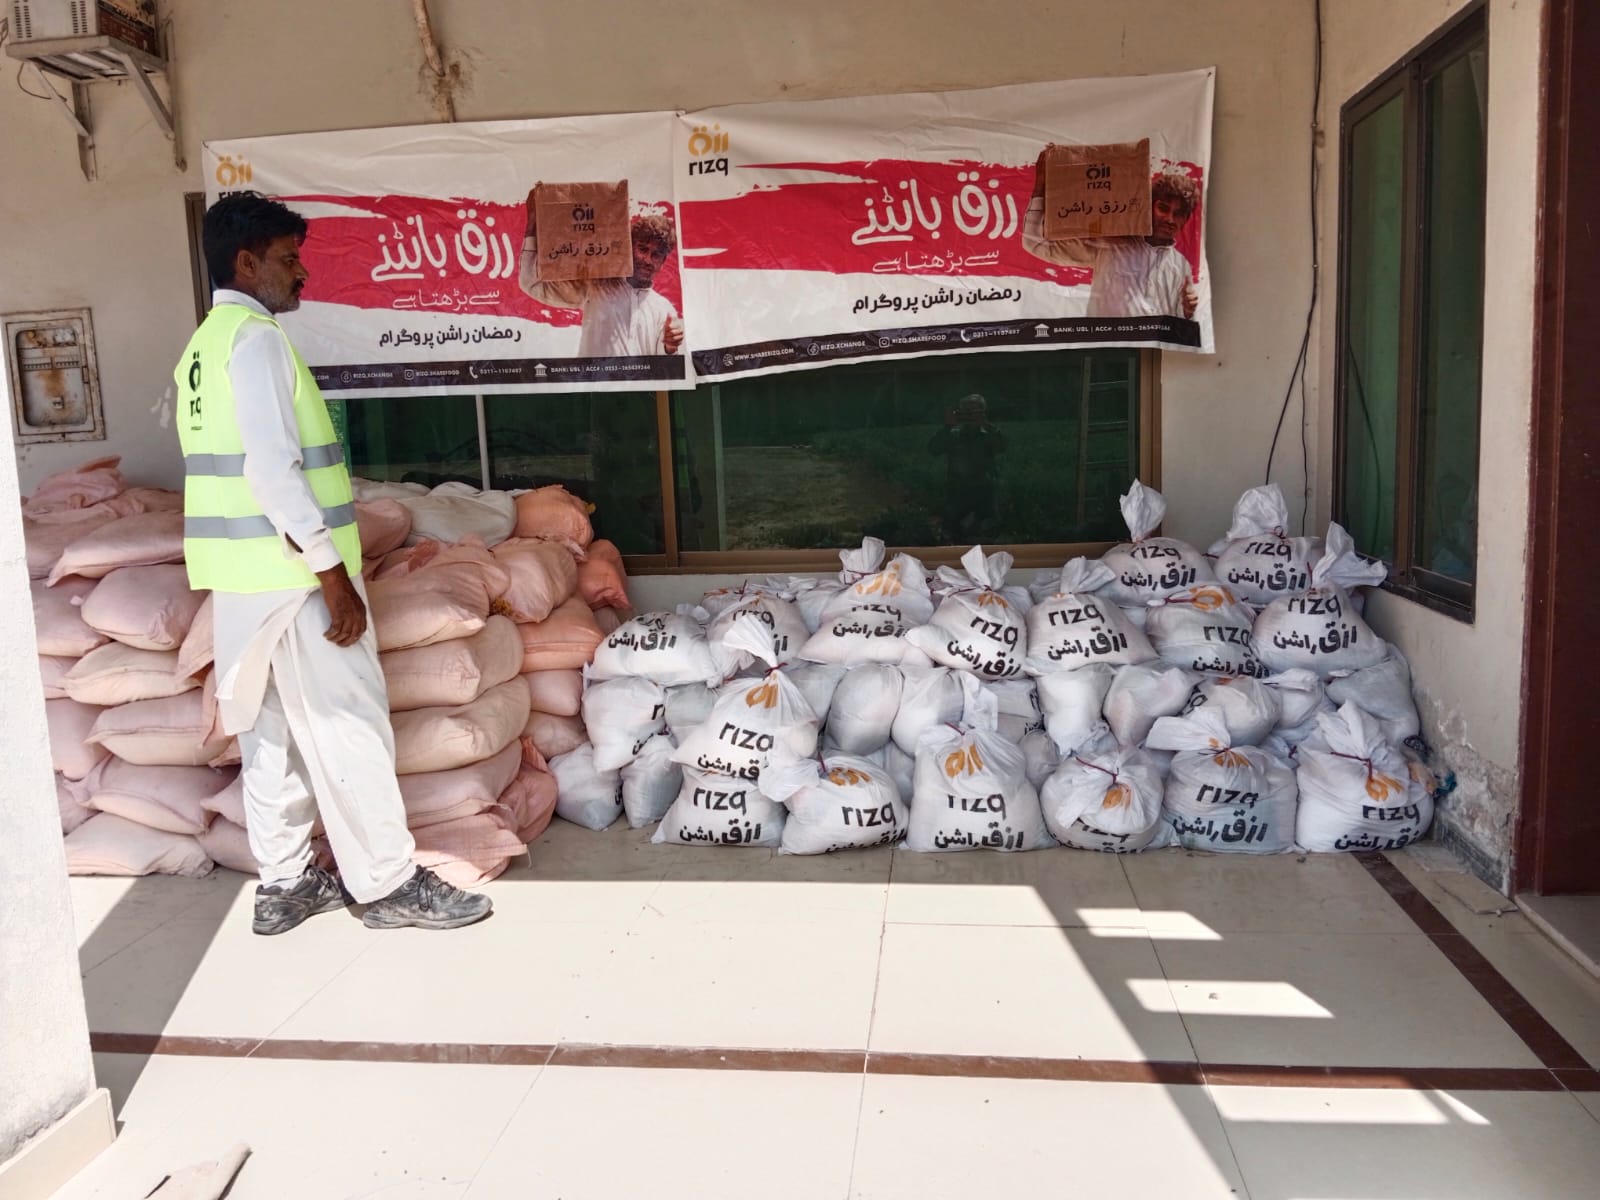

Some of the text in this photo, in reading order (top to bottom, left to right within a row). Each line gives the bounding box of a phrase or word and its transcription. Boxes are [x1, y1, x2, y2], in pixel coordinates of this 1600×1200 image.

[689, 158, 729, 176] rizq
[1087, 181, 1111, 191] rizq
[952, 171, 1018, 239] رزق
[1058, 201, 1127, 218] رزق راشن
[574, 223, 595, 234] rizq
[455, 209, 515, 279] رزق
[549, 242, 610, 260] رزق راشن
[964, 249, 1000, 266] سے
[468, 289, 500, 305] سے
[853, 287, 1021, 314] رمضان راشن پروگرام
[379, 325, 522, 348] رمضان راشن پروگرام
[1130, 546, 1182, 560] rizq
[1244, 542, 1292, 563] rizq
[1121, 572, 1159, 591] راشن
[1228, 568, 1265, 590] راشن
[1048, 604, 1105, 626] rizq
[1288, 595, 1342, 618] rizq
[608, 631, 639, 651] راشن
[833, 622, 872, 639] راشن
[970, 616, 1018, 652] rizq
[1203, 626, 1253, 655] rizq
[1048, 639, 1090, 660] راشن
[1273, 630, 1317, 655] راشن
[947, 640, 982, 670] راشن
[1192, 656, 1236, 675] راشن
[697, 754, 737, 778] راشن
[694, 787, 747, 816] rizq
[1196, 784, 1259, 808] rizq
[841, 802, 897, 828] rizq
[680, 826, 719, 844] راشن
[935, 828, 980, 849] راشن
[1172, 815, 1219, 842] راشن
